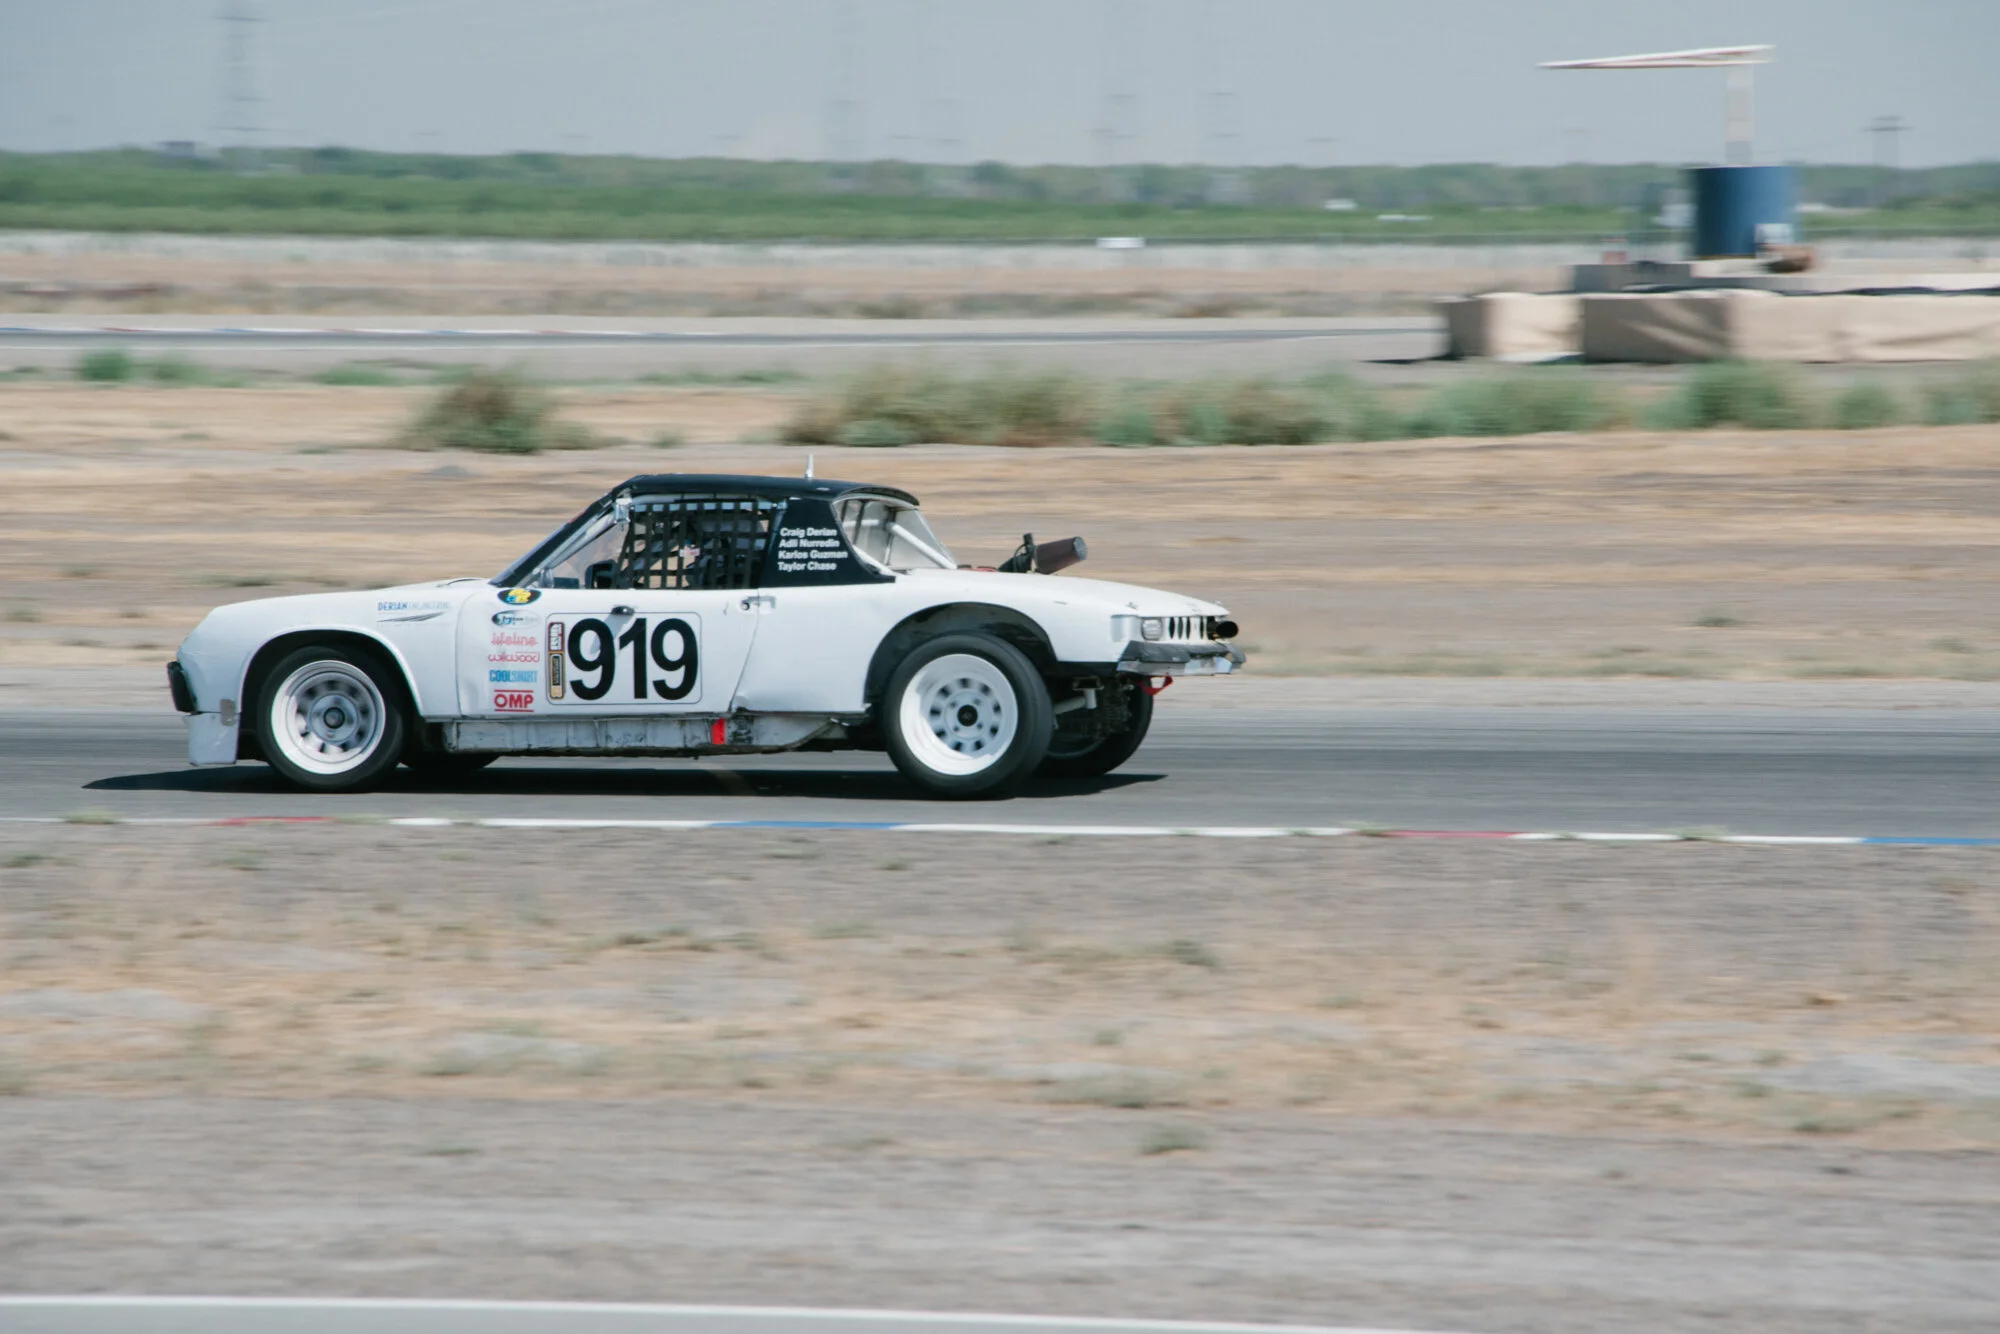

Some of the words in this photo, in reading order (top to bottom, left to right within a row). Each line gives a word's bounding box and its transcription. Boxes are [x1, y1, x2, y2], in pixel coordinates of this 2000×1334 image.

[780, 528, 805, 538] Craig
[806, 527, 837, 536] Derian
[778, 550, 808, 559] Karlos
[810, 550, 848, 558] Guzman
[778, 561, 806, 572] Taylor
[807, 561, 837, 570] Chase
[490, 632, 539, 647] lifeline
[567, 617, 699, 701] 919
[494, 693, 534, 709] OMP
